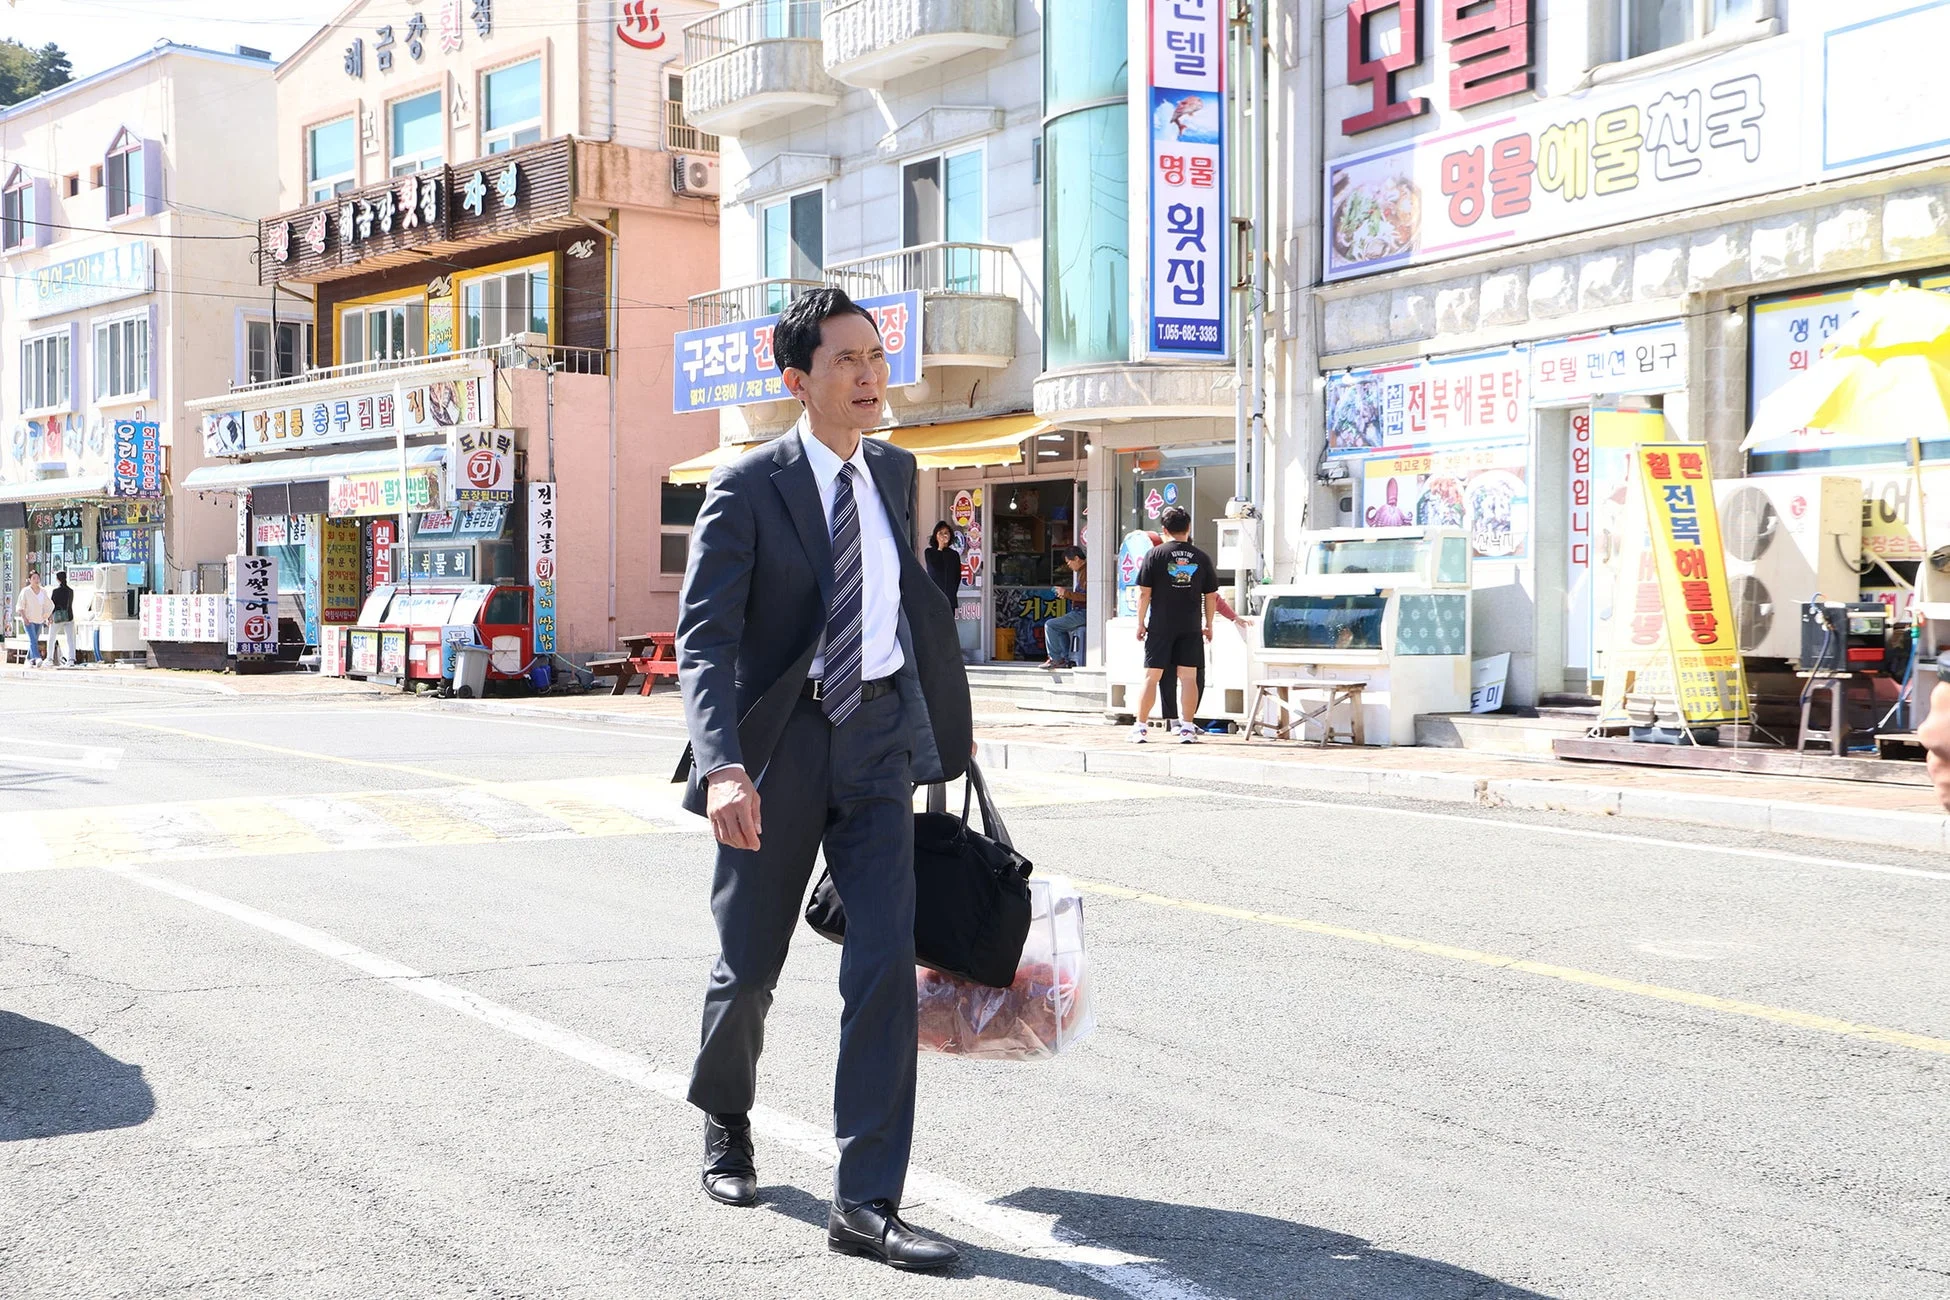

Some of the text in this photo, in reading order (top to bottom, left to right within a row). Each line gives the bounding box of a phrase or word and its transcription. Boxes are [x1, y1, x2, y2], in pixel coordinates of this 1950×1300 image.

[1159, 154, 1215, 189] 명물
[463, 162, 518, 217] 자연
[1166, 203, 1207, 307] 횟집
[683, 331, 749, 383] 구조라
[1540, 357, 1578, 382] 모텔
[1636, 342, 1677, 372] 입구
[406, 389, 425, 424] 집
[714, 383, 738, 402] 오징어
[746, 380, 763, 397] 젓갈
[1407, 369, 1523, 433] 전복해물탕
[460, 431, 511, 459] 도시락
[468, 456, 502, 486] 회
[1644, 450, 1704, 481] 철판
[338, 480, 379, 509] 생선구이
[1662, 484, 1702, 545] 전복
[1673, 547, 1719, 646] 해물탕
[244, 616, 272, 642] 회
